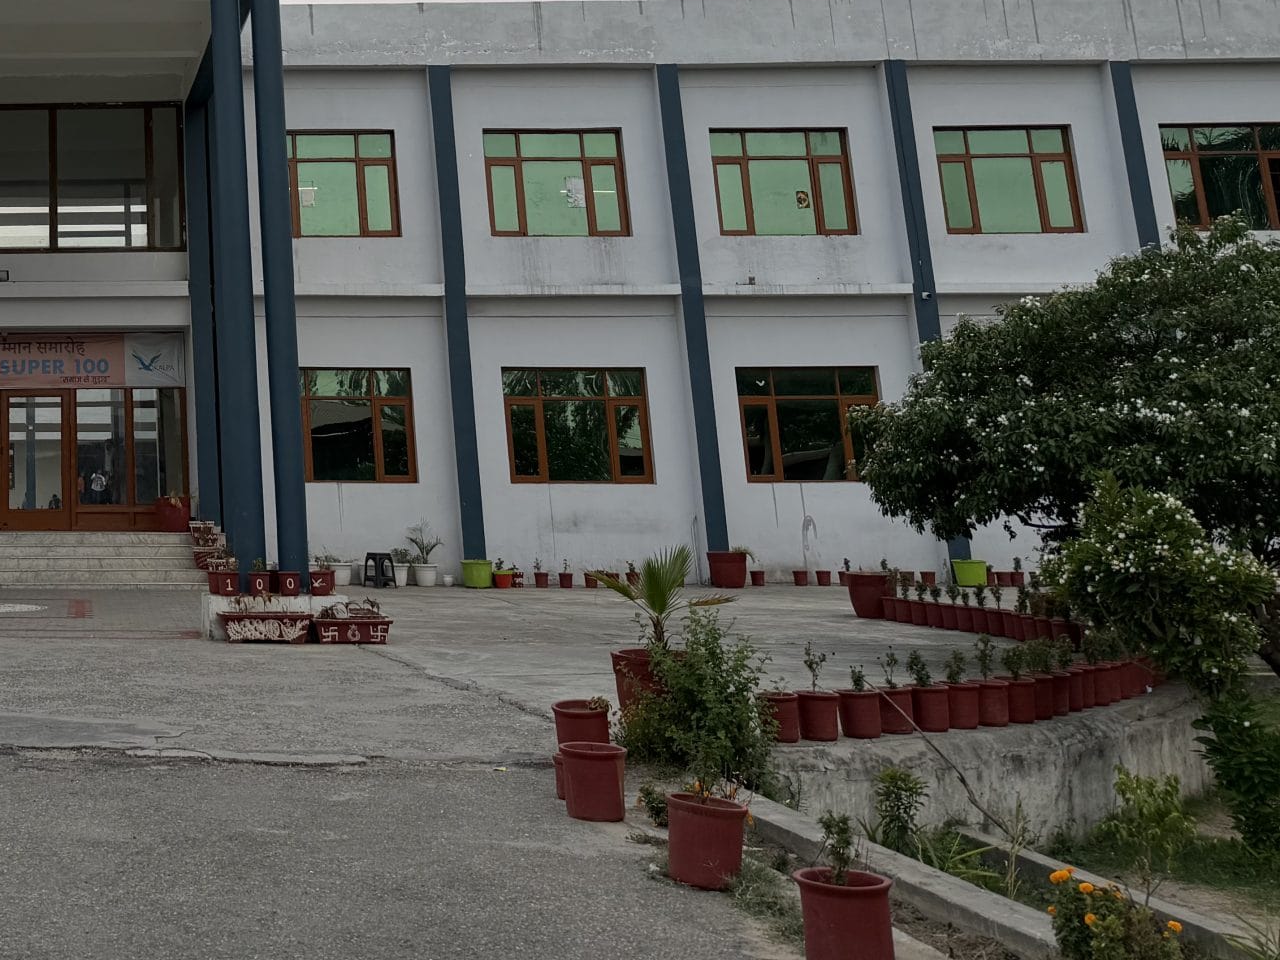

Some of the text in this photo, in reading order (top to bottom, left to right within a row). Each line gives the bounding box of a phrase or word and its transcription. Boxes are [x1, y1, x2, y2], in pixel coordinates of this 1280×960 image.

[37, 337, 86, 355] समारोह
[0, 359, 64, 375] SUPER
[74, 358, 109, 374] 100
